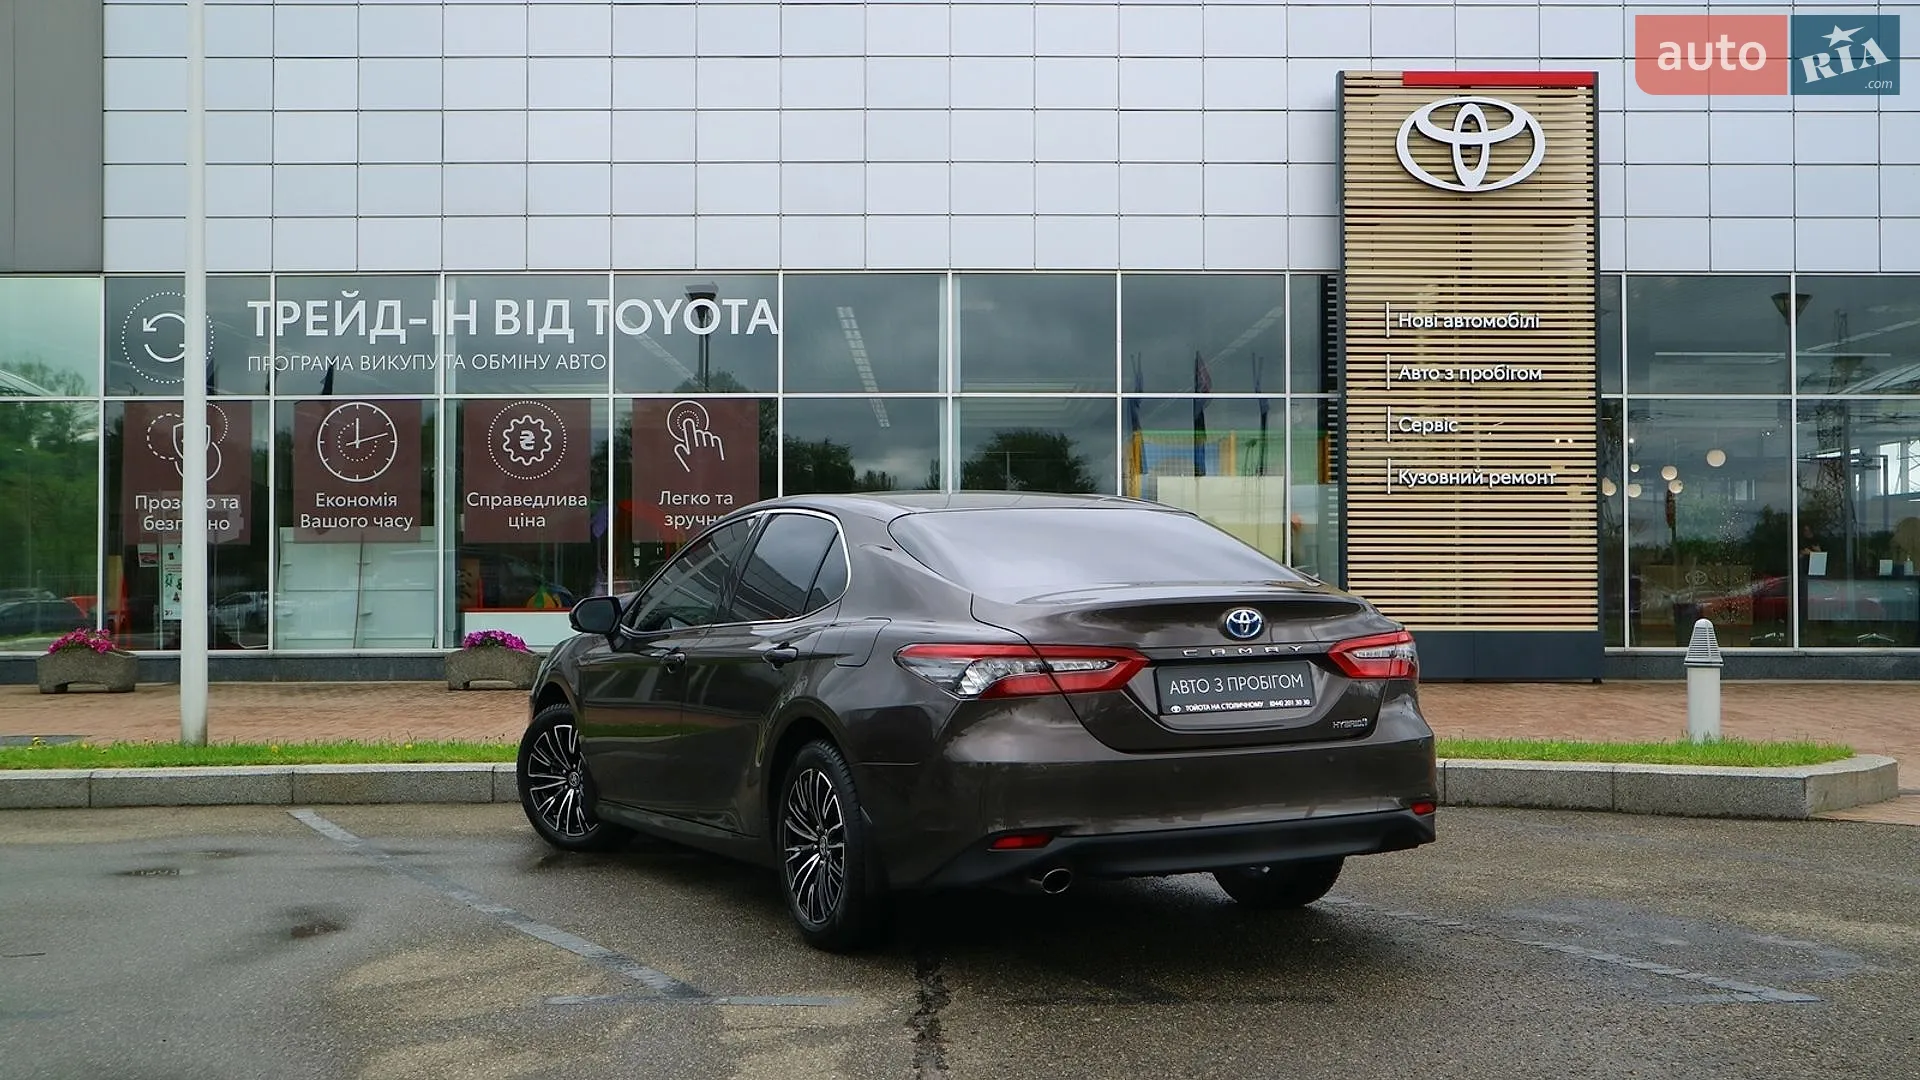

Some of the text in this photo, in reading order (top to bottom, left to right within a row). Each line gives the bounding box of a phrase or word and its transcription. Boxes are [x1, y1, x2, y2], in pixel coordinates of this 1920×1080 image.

[247, 290, 779, 345] ТРЕЙД-ІН ВІД TOYOTA
[1398, 312, 1540, 329] Нові автомобілі
[248, 353, 607, 371] ПРОГРАМА ВИКУПУ ТА ОБМІНУ АВТО
[1398, 364, 1543, 385] Авто з пробігом
[1398, 417, 1459, 437] Сервіс
[1398, 468, 1557, 489] Кузовний ремонт
[135, 495, 239, 513] Прозо та
[315, 493, 397, 507] Економія
[466, 491, 588, 509] Справедлива
[659, 490, 733, 505] Легко та
[300, 514, 413, 530] Вашого часу
[508, 513, 545, 527] ціна
[664, 514, 724, 529] зручн
[1183, 645, 1302, 656] CAMRY
[1169, 679, 1210, 695] АВТО
[1227, 674, 1304, 691] ПРОБІГОМ
[1221, 701, 1264, 709] СТОЛИЧНОМУ
